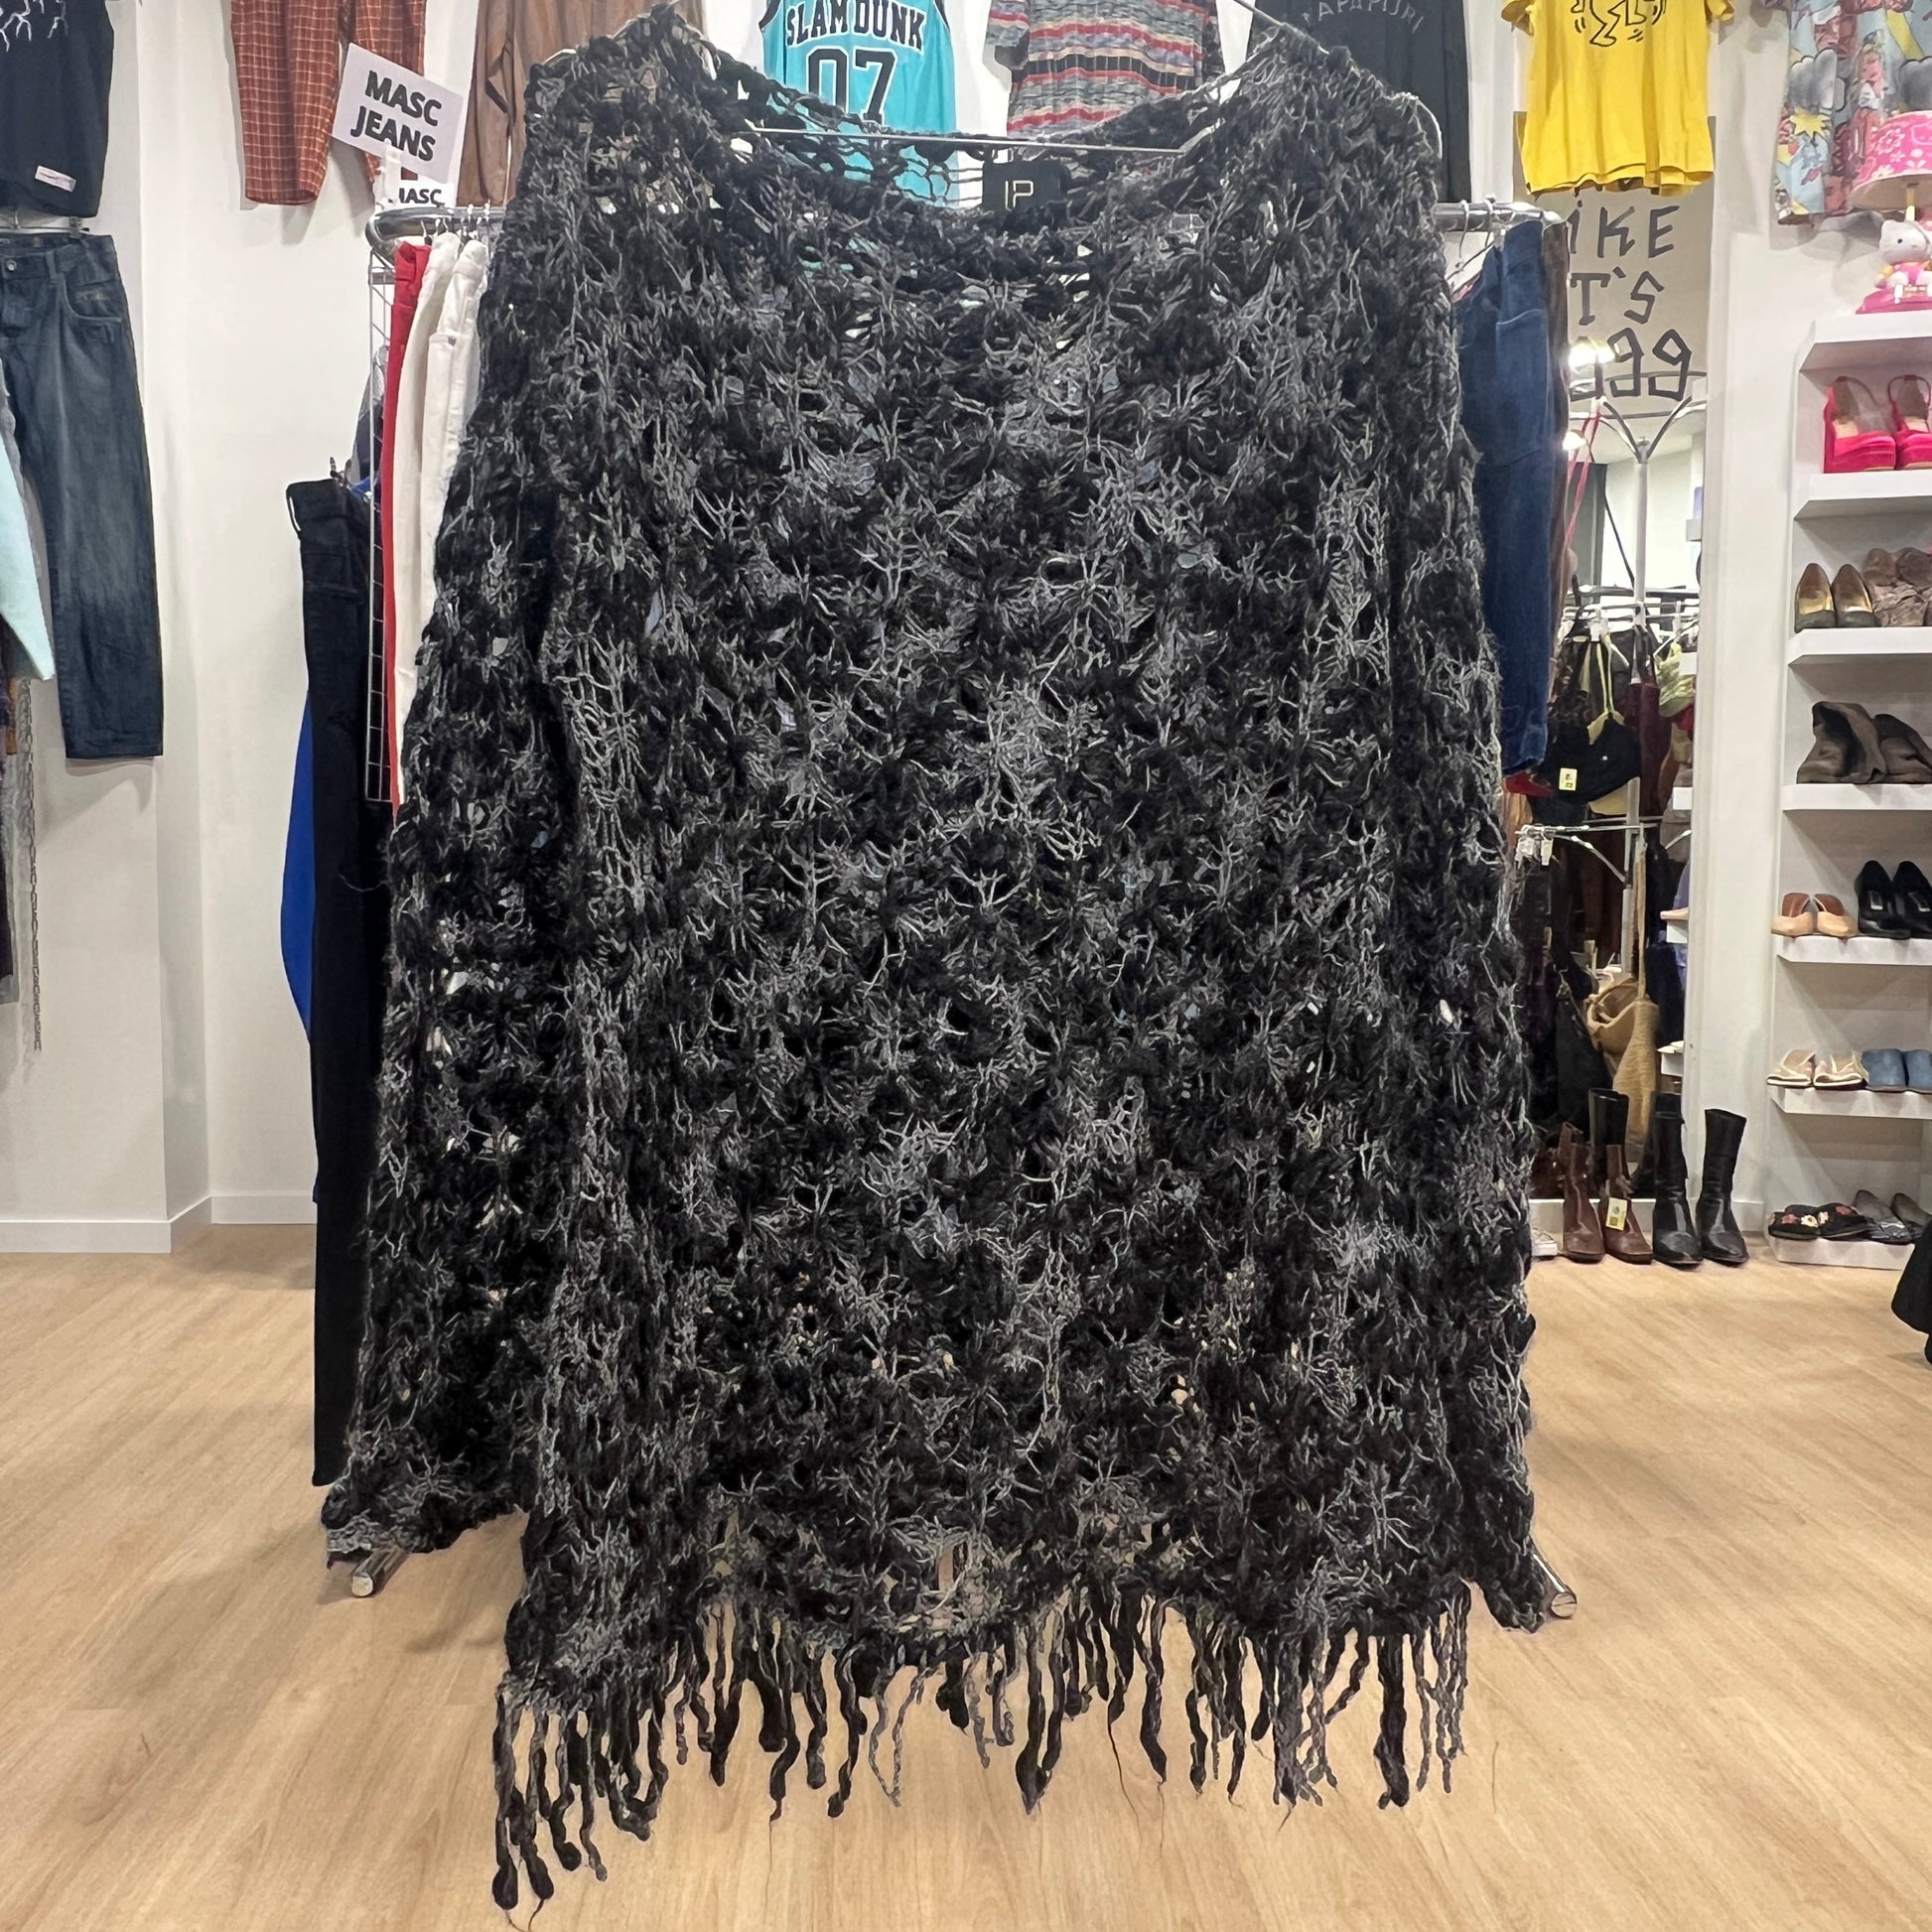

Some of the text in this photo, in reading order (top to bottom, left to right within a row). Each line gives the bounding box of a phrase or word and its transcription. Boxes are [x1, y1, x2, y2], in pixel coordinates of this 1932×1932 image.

[785, 0, 927, 54] SLAM DUNK
[364, 69, 443, 127] MASC
[806, 46, 898, 127] 07
[349, 105, 437, 162] JEANS
[1569, 266, 1665, 325] T'S
